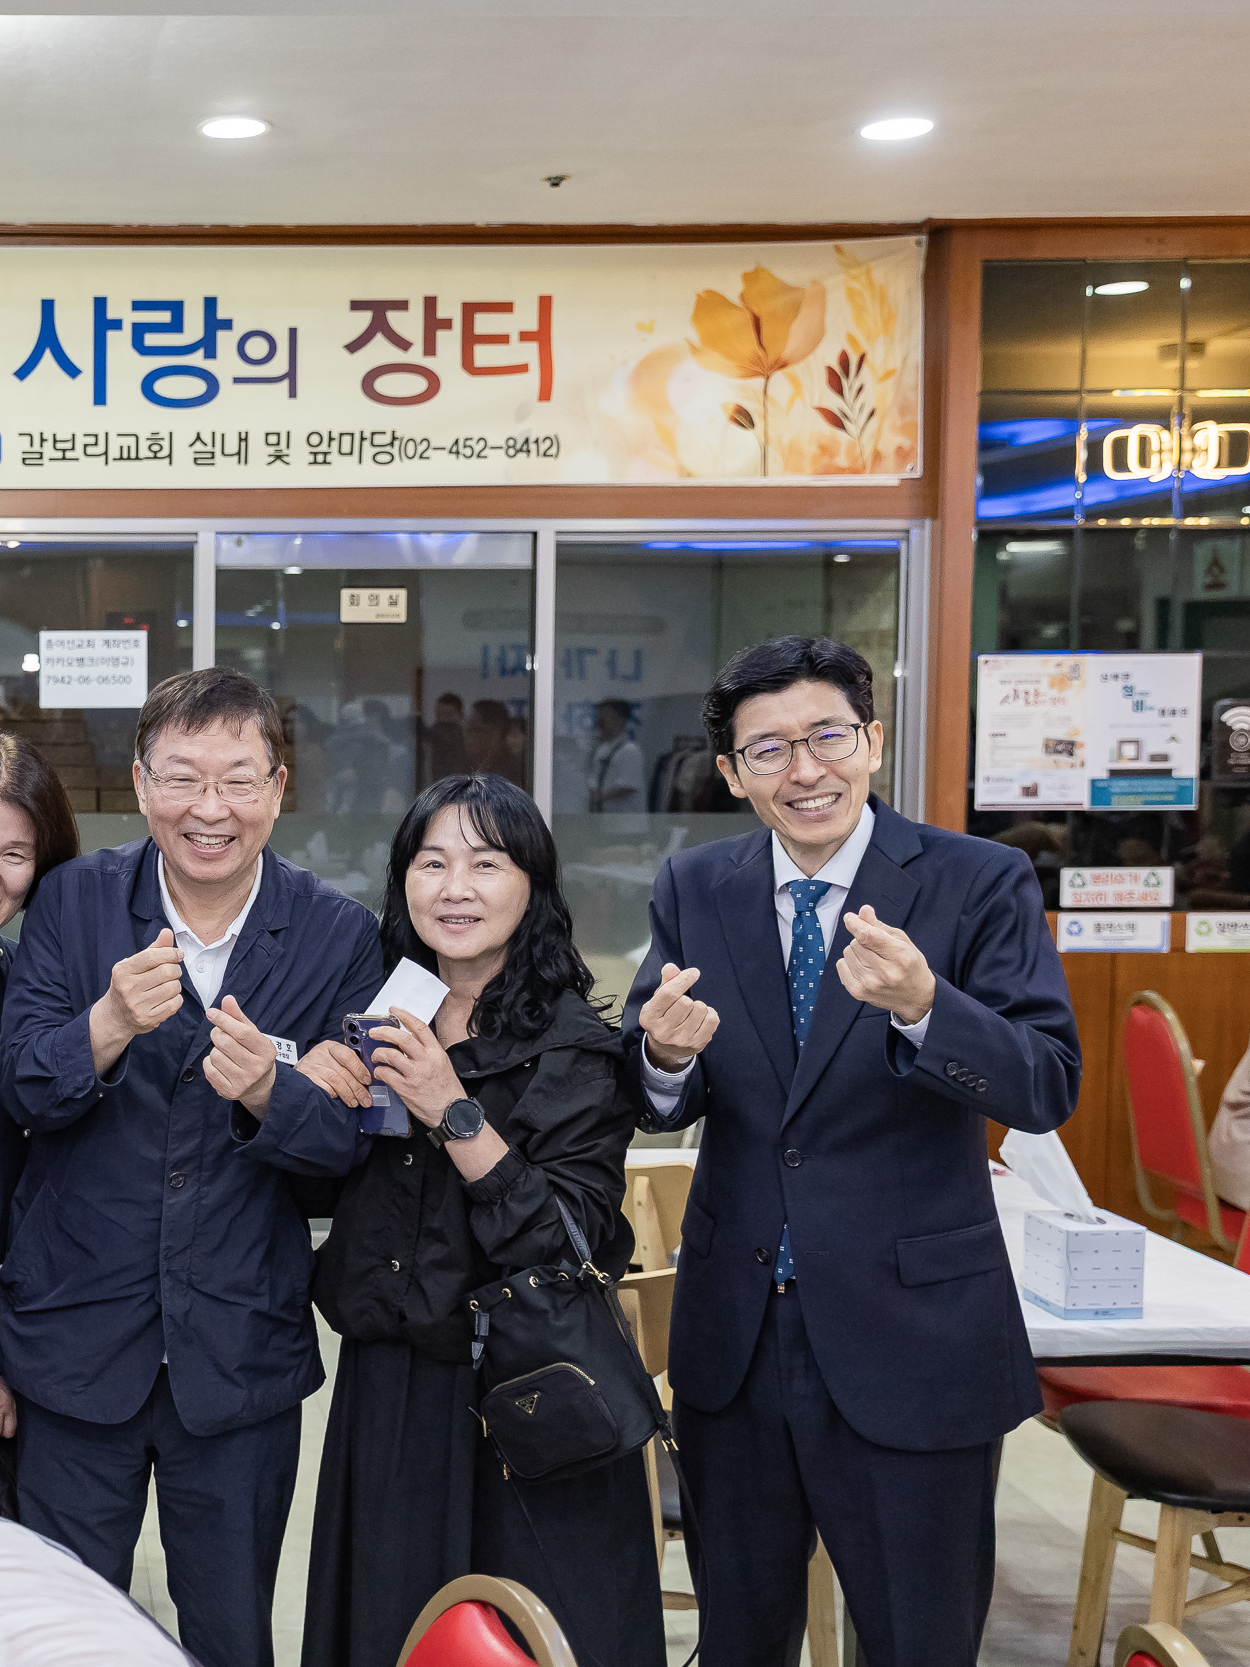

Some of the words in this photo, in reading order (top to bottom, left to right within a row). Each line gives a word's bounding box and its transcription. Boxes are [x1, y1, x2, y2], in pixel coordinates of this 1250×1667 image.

[12, 296, 298, 409] 사랑의
[342, 295, 553, 408] 장터
[17, 430, 173, 467] 갈보리교회
[188, 430, 250, 467] 실내
[264, 430, 291, 467] 및
[306, 430, 561, 467] 앞마당(02-452-8412)
[101, 638, 141, 651] 계좌번호
